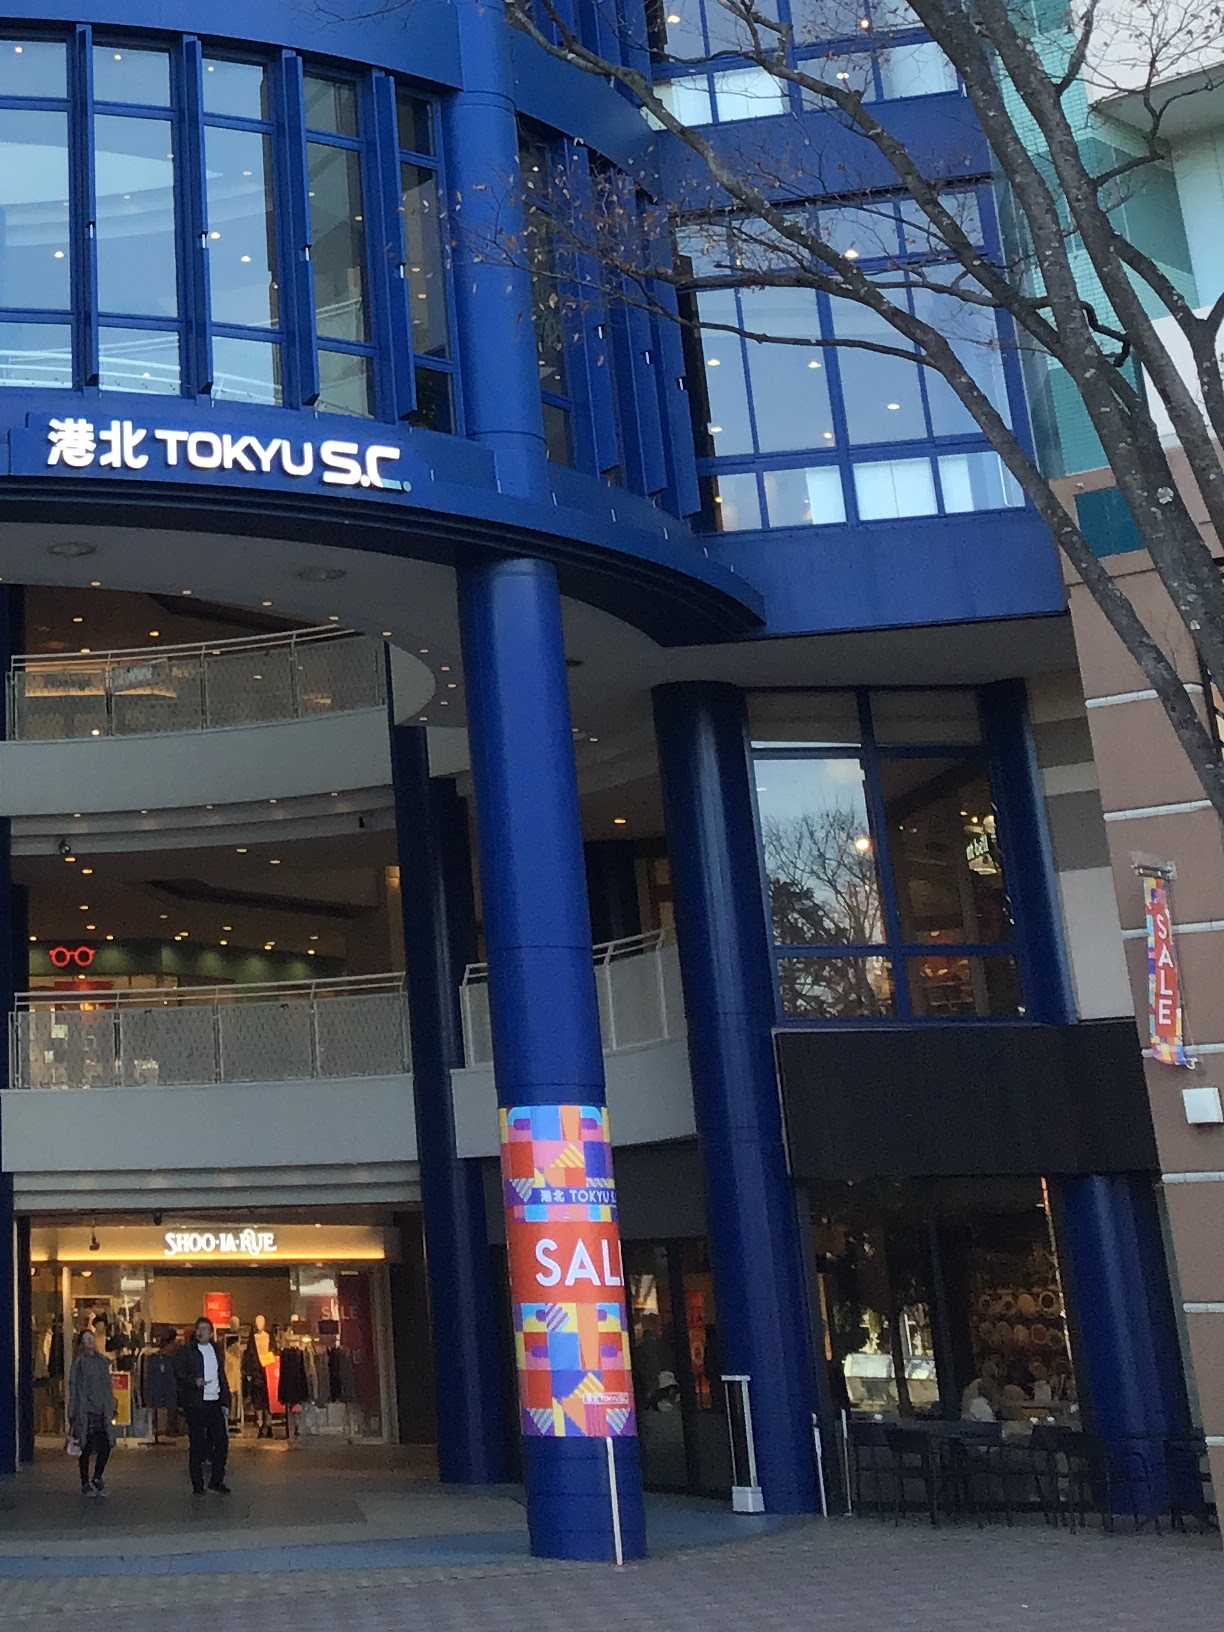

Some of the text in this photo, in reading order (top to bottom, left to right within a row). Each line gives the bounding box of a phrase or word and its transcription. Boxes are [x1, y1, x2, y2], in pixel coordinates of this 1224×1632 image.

[47, 417, 150, 470] 港北
[154, 429, 314, 476] TOKYU
[1156, 913, 1174, 1026] SALE
[569, 1189, 610, 1203] TOKYU
[535, 1237, 625, 1287] SAL
